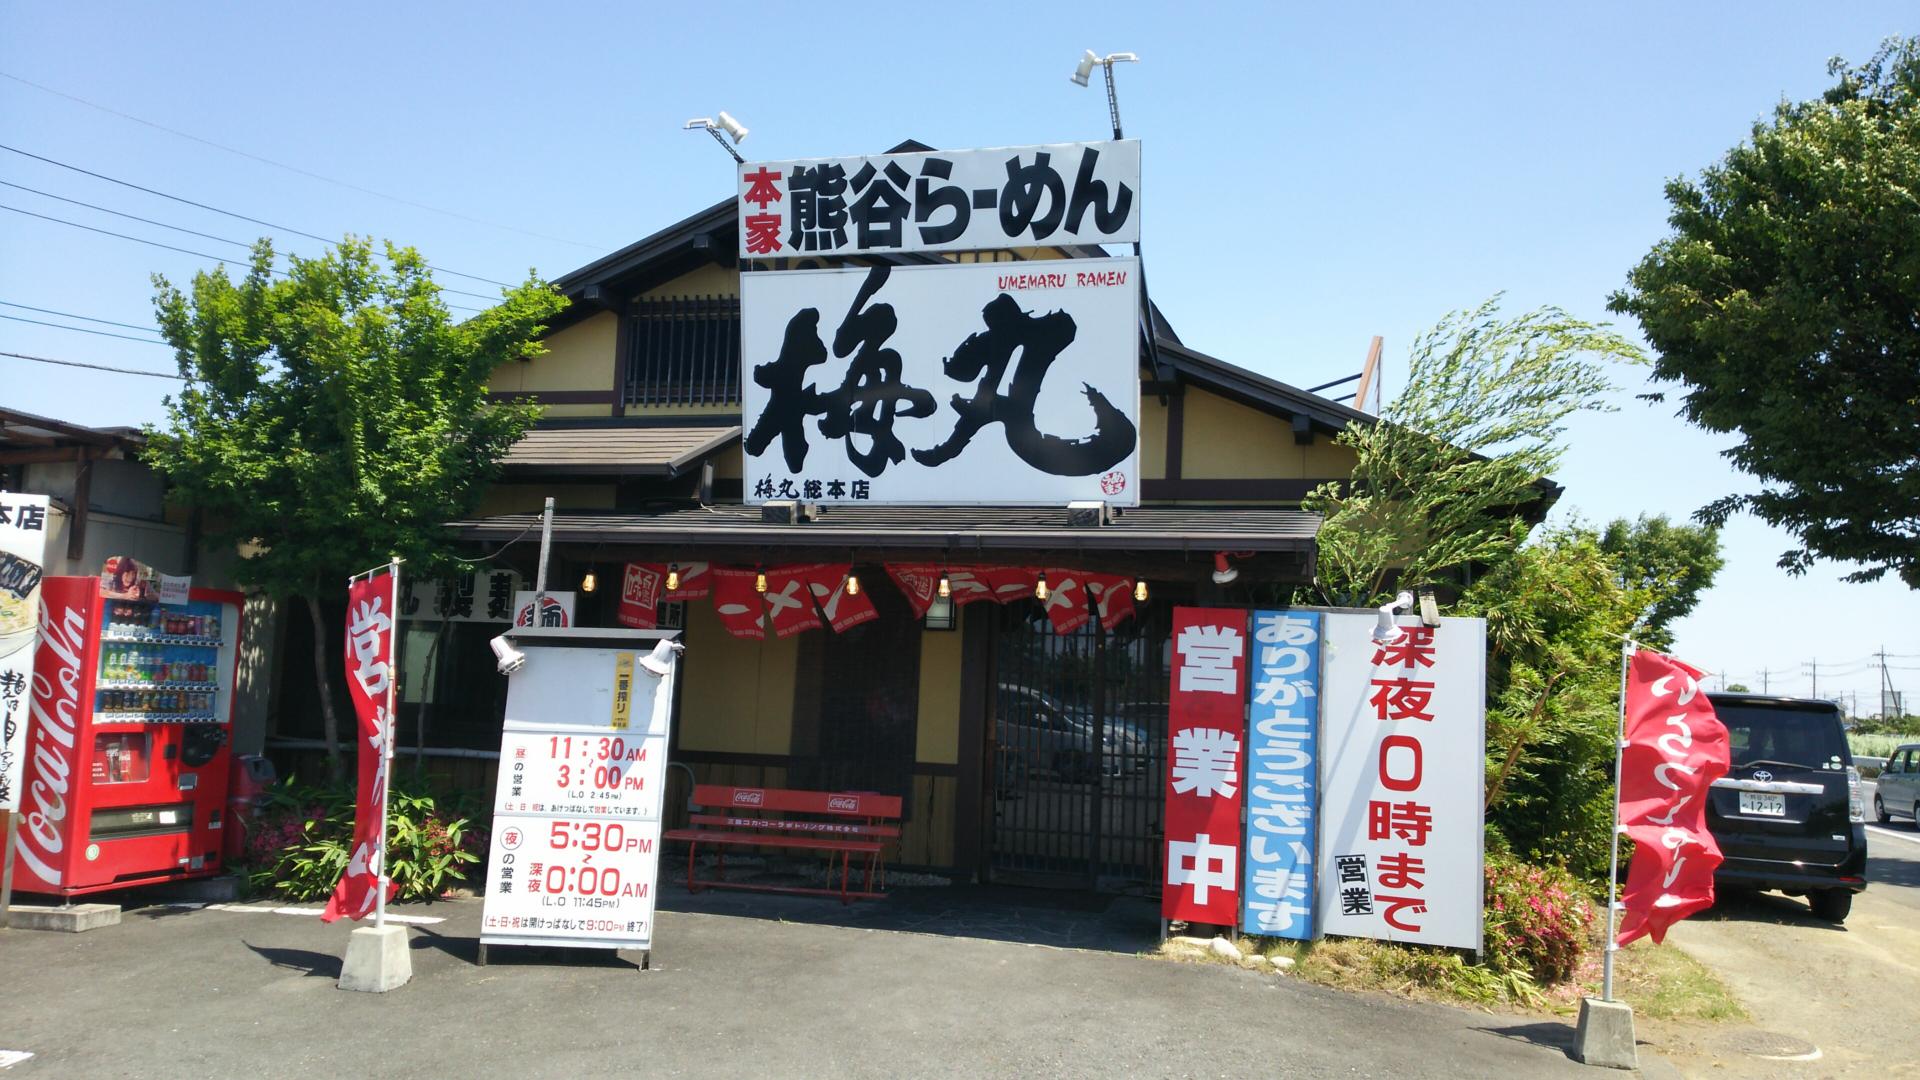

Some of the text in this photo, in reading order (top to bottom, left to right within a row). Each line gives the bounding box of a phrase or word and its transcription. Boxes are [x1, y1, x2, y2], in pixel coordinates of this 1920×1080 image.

[744, 166, 783, 255] 本家
[787, 146, 1133, 252] 熊谷らーめん
[998, 271, 1127, 290] UMEMARU RAMEN
[744, 266, 1137, 477] 梅丸
[754, 473, 870, 500] 梅丸総本店
[15, 600, 86, 887] Coca-Cola
[347, 596, 392, 913] 営業
[550, 736, 646, 762] 11:30 AM
[1167, 624, 1244, 906] 営業中
[557, 764, 644, 790] 3:00 PM
[1248, 614, 1319, 932] ありがとうございます
[1750, 800, 1783, 814] 12-12
[500, 827, 523, 894] 夜の営業
[549, 821, 652, 853] 5:30 PM
[528, 863, 543, 893] 深夜
[546, 865, 648, 898] 0:00 AM
[1338, 857, 1373, 914] 営業
